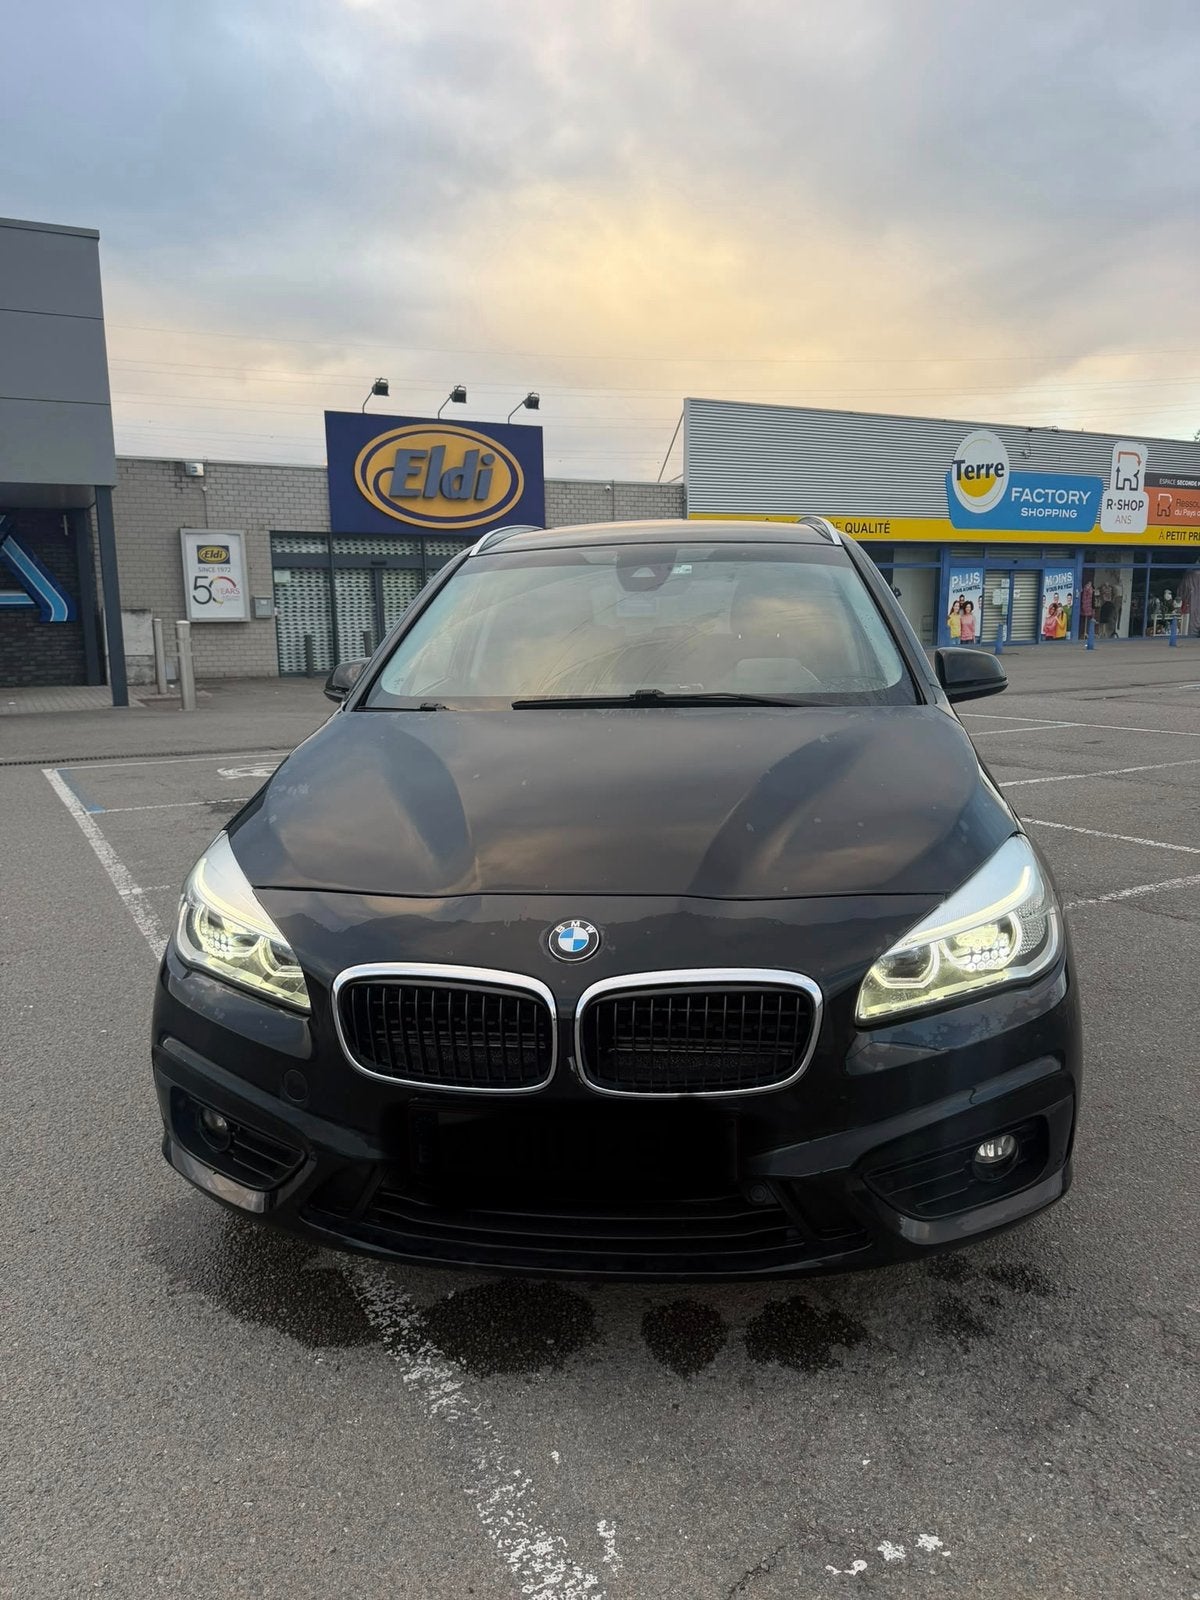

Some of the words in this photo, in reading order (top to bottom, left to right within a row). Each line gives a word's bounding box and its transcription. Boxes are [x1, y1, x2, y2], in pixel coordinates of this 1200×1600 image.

[389, 445, 496, 501] Eldi
[952, 460, 1005, 481] Terre
[1177, 479, 1197, 487] SECONDE
[1011, 487, 1091, 505] FACTORY
[1021, 507, 1077, 518] SHOPPING
[1182, 509, 1195, 518] Pays
[1114, 515, 1132, 525] ANS
[845, 520, 890, 534] QUALITÉ
[1166, 531, 1187, 541] PETIT
[204, 550, 223, 559] Eldi
[951, 572, 980, 588] PLUS
[1045, 572, 1072, 586] MOINS
[555, 921, 596, 934] BMW
